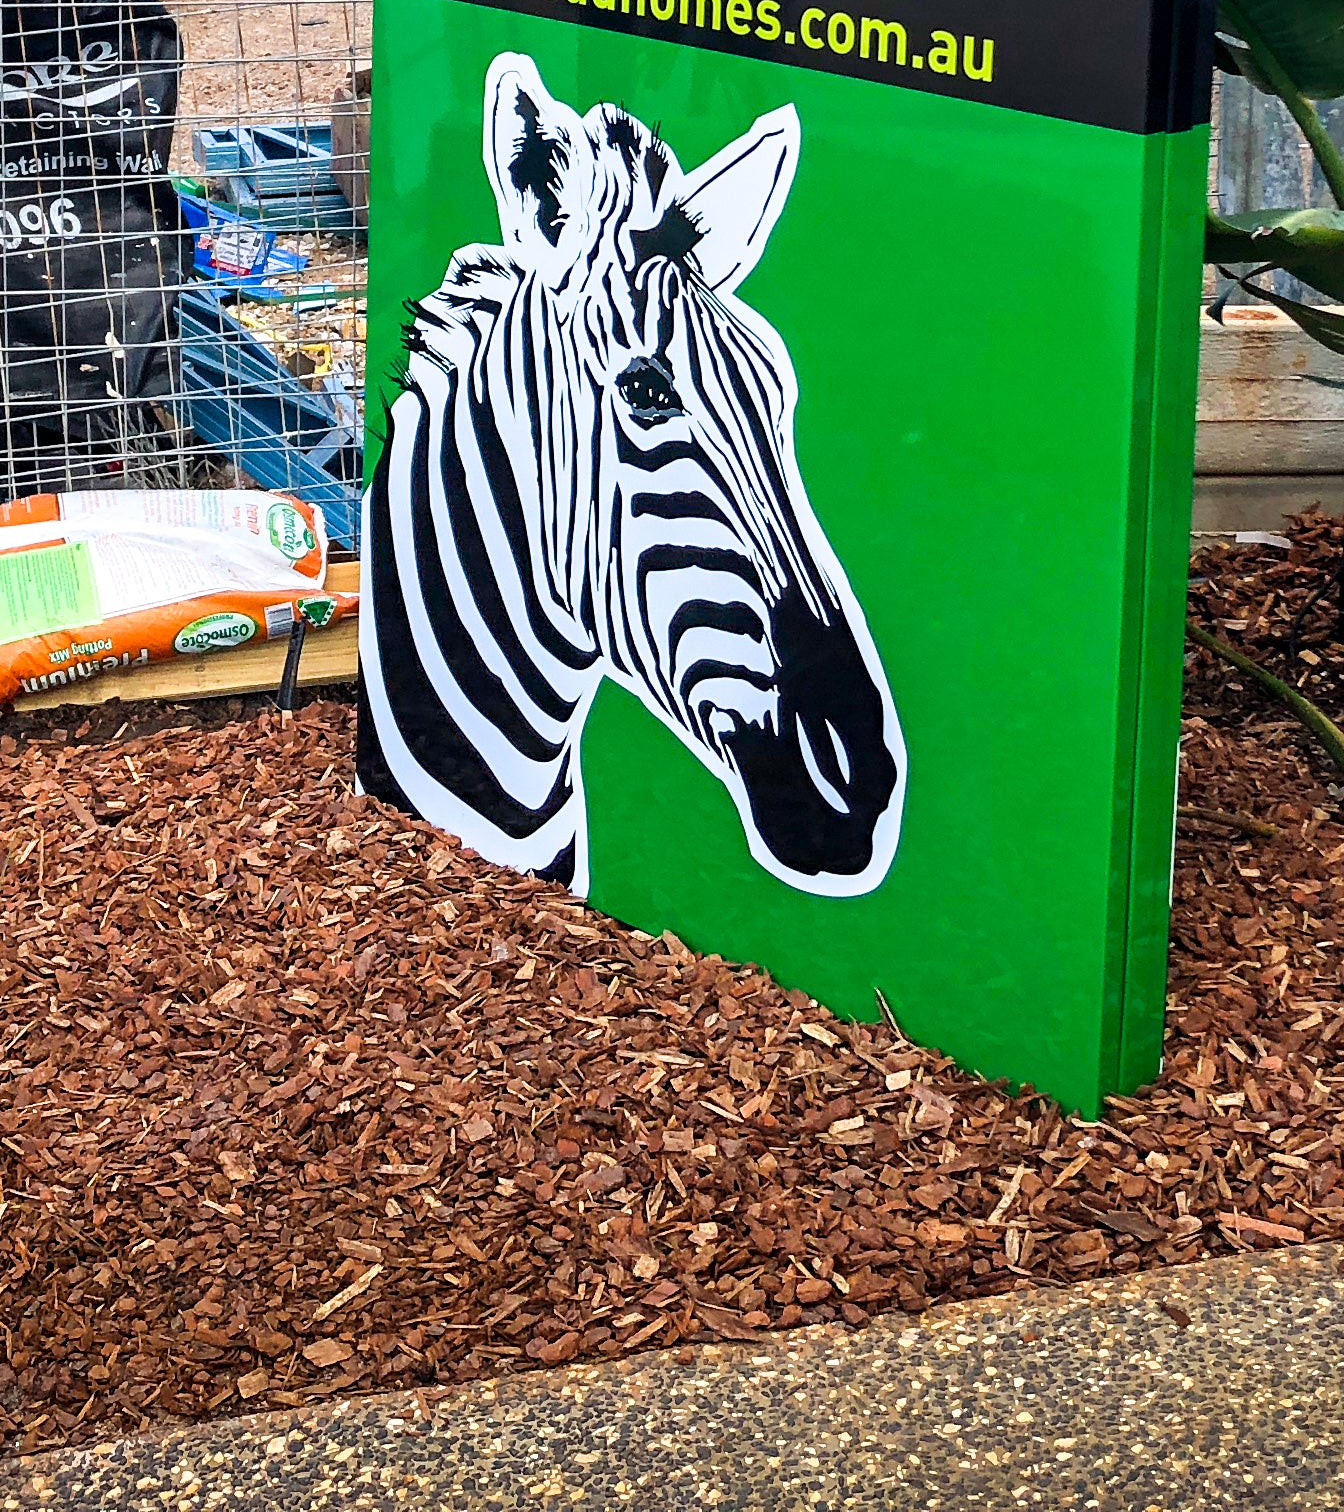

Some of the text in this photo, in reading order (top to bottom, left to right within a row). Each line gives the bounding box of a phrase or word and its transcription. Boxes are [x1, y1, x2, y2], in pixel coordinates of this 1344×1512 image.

[181, 623, 250, 649] Osmocote
[48, 637, 113, 664] Potting Mix
